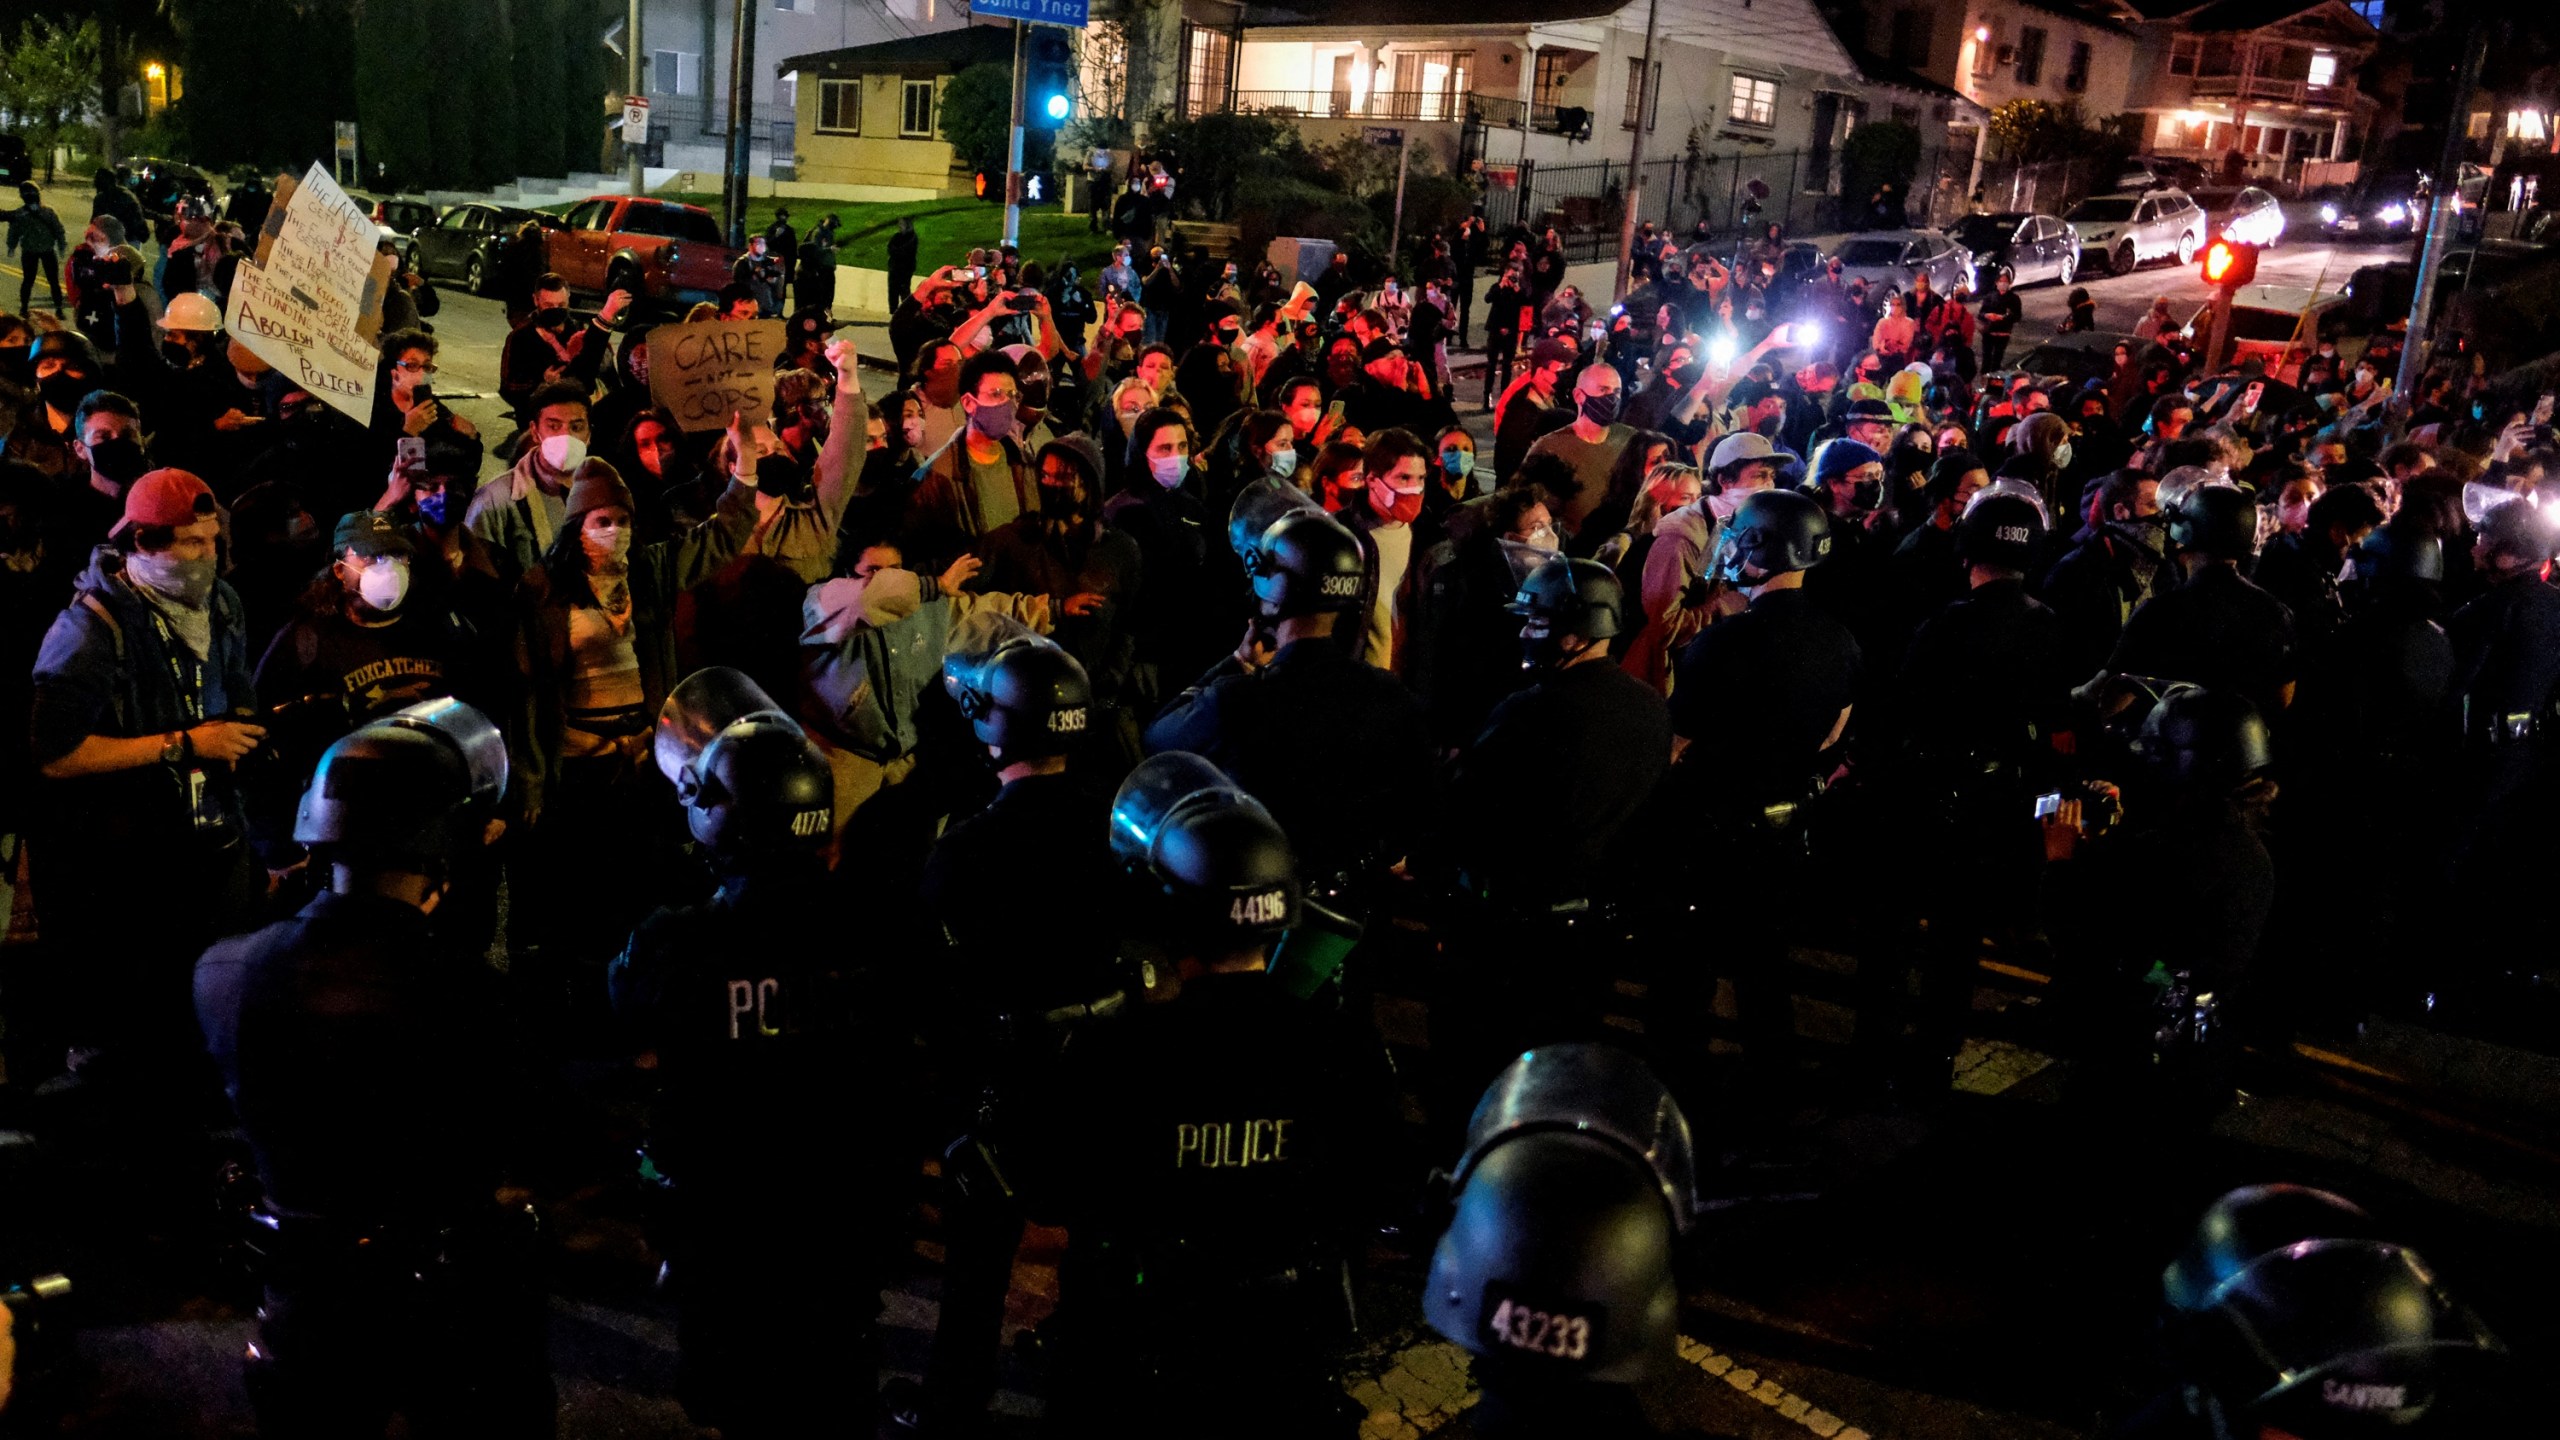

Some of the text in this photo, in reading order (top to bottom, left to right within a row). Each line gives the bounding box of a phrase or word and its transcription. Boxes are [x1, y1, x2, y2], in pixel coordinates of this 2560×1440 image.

[1040, 0, 1082, 18] Ynez
[288, 205, 305, 232] THE
[307, 167, 366, 236] THE LAPD
[307, 201, 335, 227] GETS
[239, 300, 313, 348] ABOLISH
[242, 280, 312, 331] DEFUNDING
[327, 332, 347, 348] NOT
[343, 343, 375, 372] ENOUGH
[243, 265, 262, 285] THE
[265, 277, 298, 306] SYSTEM
[316, 309, 367, 353] CORRUPT
[286, 340, 305, 358] THE
[674, 330, 763, 371] CARE
[683, 387, 762, 420] COPS
[1320, 575, 1360, 596] 39087
[1046, 707, 1087, 733] 43935
[1229, 890, 1286, 926] 44196
[1176, 1118, 1294, 1169] POLICE
[1490, 1297, 1591, 1361] 43233
